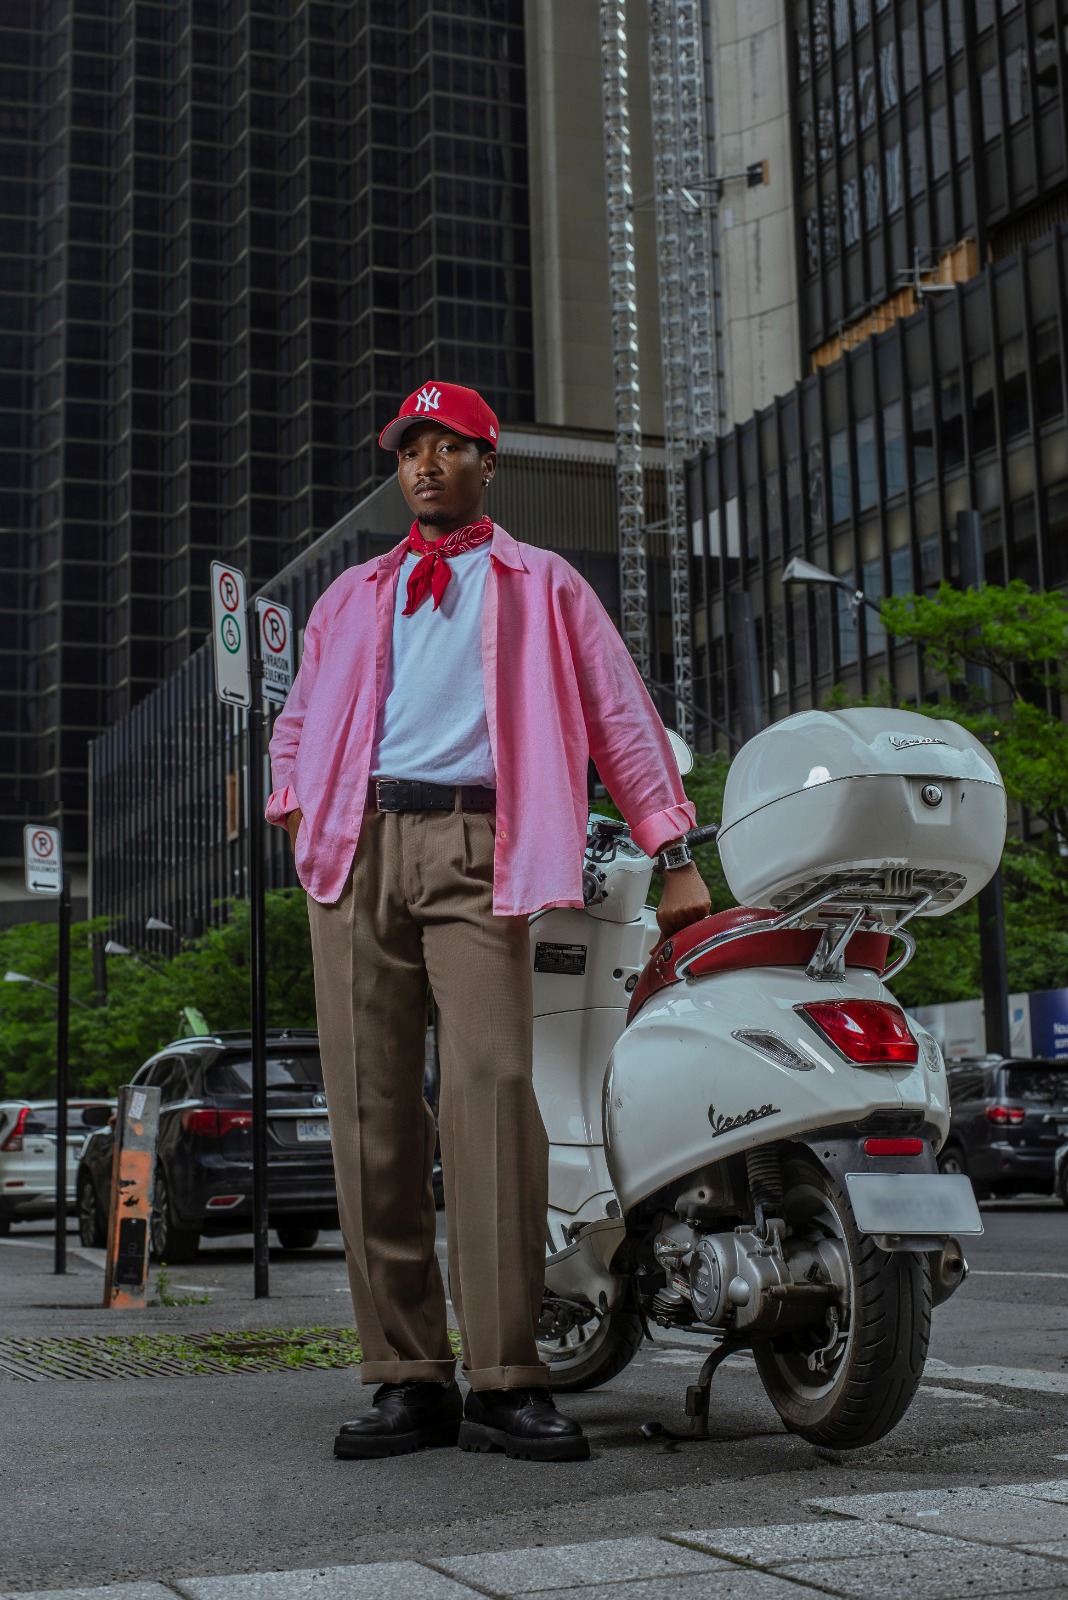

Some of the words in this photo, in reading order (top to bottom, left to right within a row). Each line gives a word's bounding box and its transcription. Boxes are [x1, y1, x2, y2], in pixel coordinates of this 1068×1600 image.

[415, 387, 441, 412] NY
[262, 652, 289, 672] LIVRAISON
[889, 735, 949, 751] Vespa
[707, 1103, 782, 1138] Vespa
